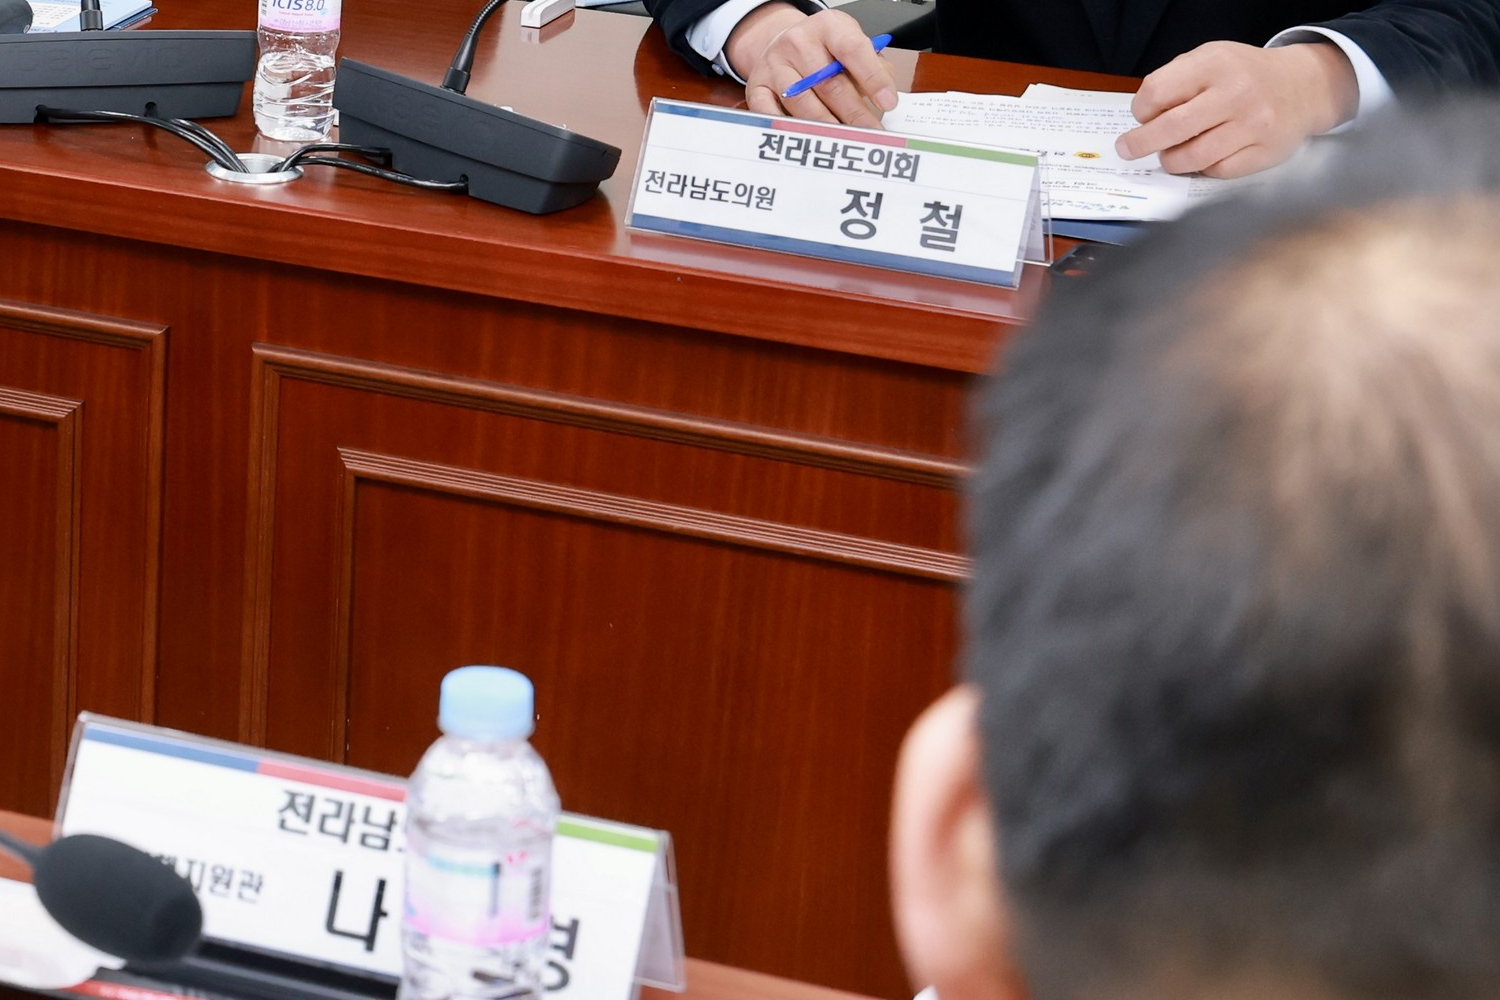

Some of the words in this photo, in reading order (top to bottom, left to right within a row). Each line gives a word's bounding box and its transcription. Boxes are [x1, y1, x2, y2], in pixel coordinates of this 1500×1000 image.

[757, 132, 921, 183] 전라남도의회
[644, 168, 777, 212] 전라남도의원
[279, 789, 403, 851] 전라남
